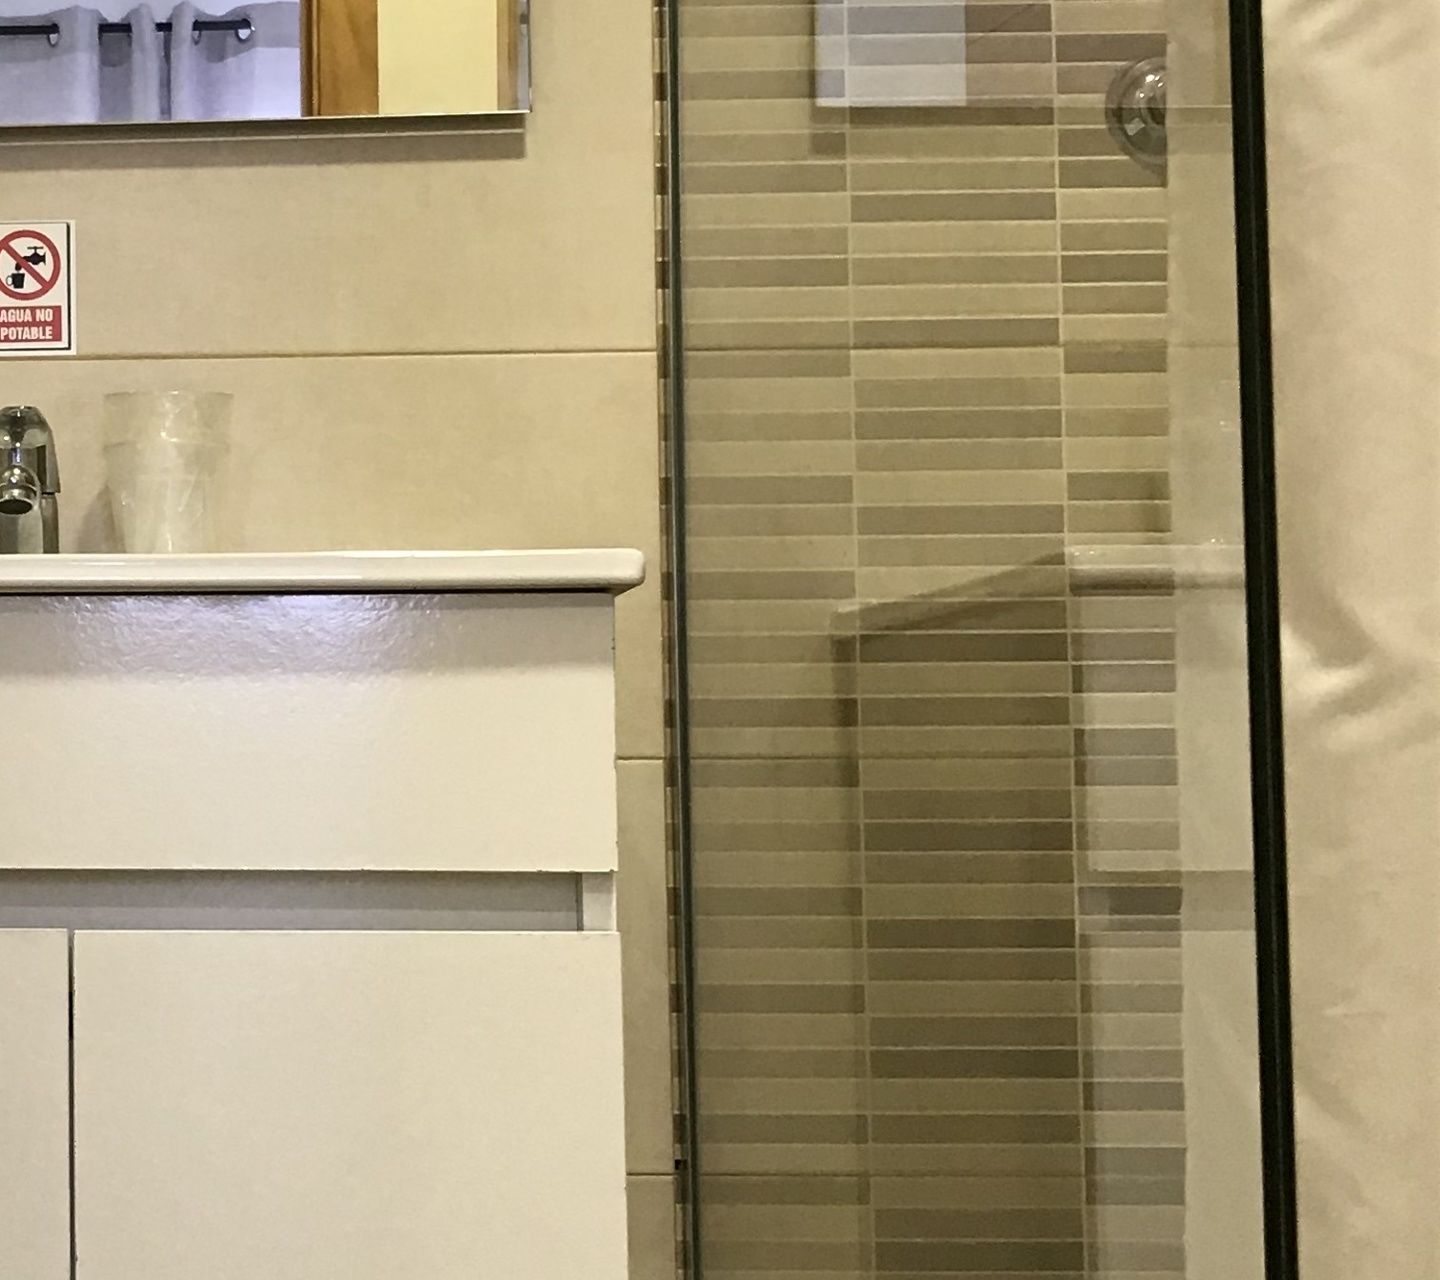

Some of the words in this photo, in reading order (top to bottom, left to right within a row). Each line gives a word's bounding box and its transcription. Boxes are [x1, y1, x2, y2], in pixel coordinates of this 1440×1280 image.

[0, 309, 32, 322] AGUA
[36, 308, 53, 321] NO
[0, 326, 53, 340] POTABLE
